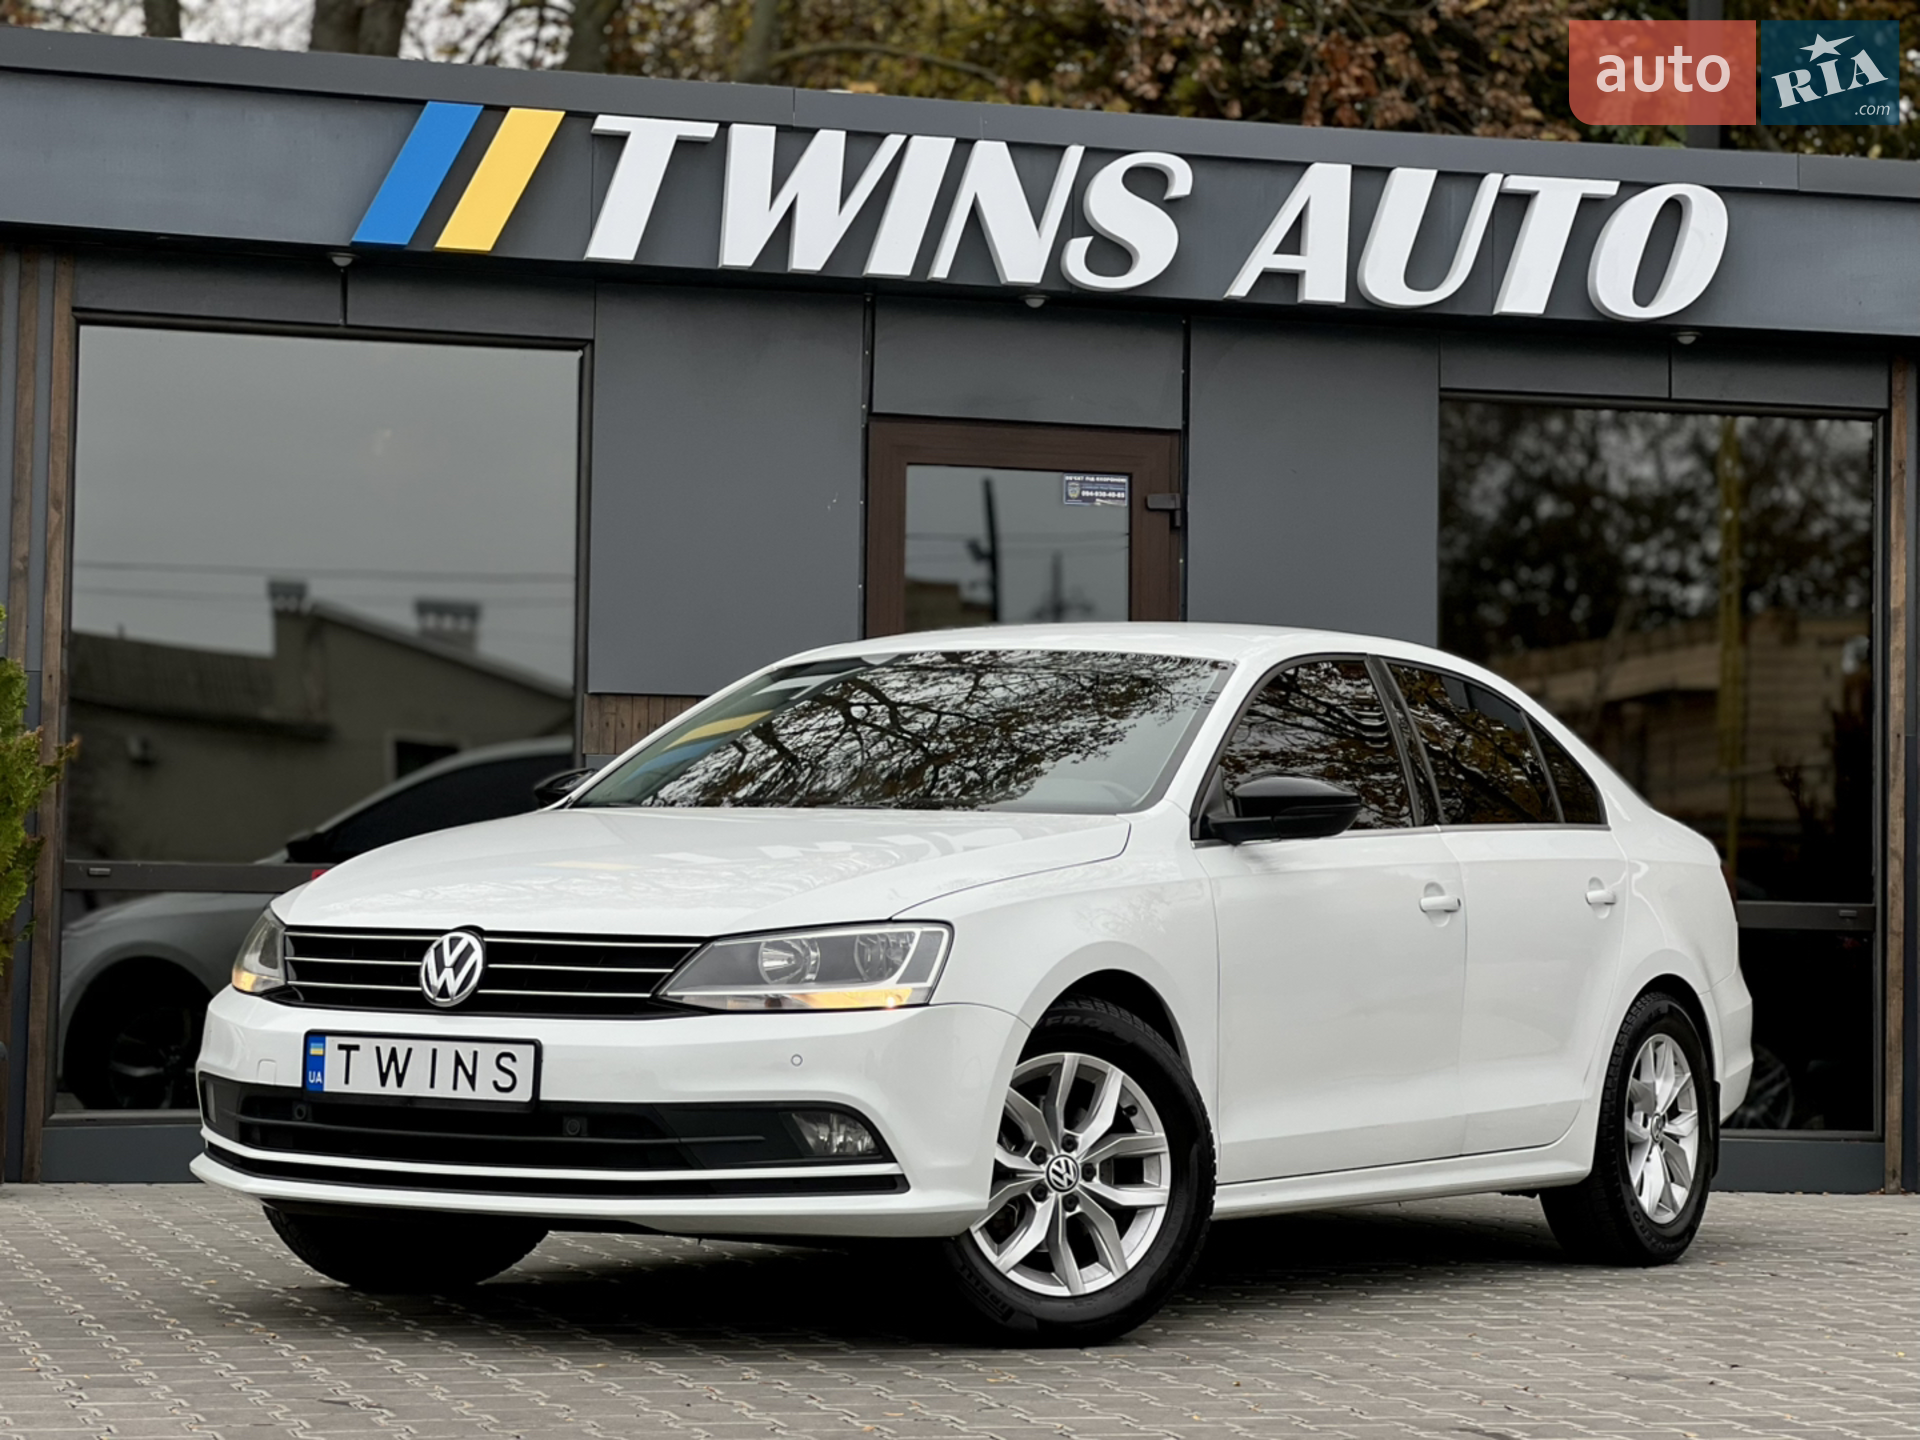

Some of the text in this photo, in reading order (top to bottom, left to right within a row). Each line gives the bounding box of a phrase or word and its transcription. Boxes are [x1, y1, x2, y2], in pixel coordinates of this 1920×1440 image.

[584, 114, 1729, 322] TWINS AUTO
[308, 1071, 323, 1084] UA
[337, 1043, 518, 1094] TWINS
